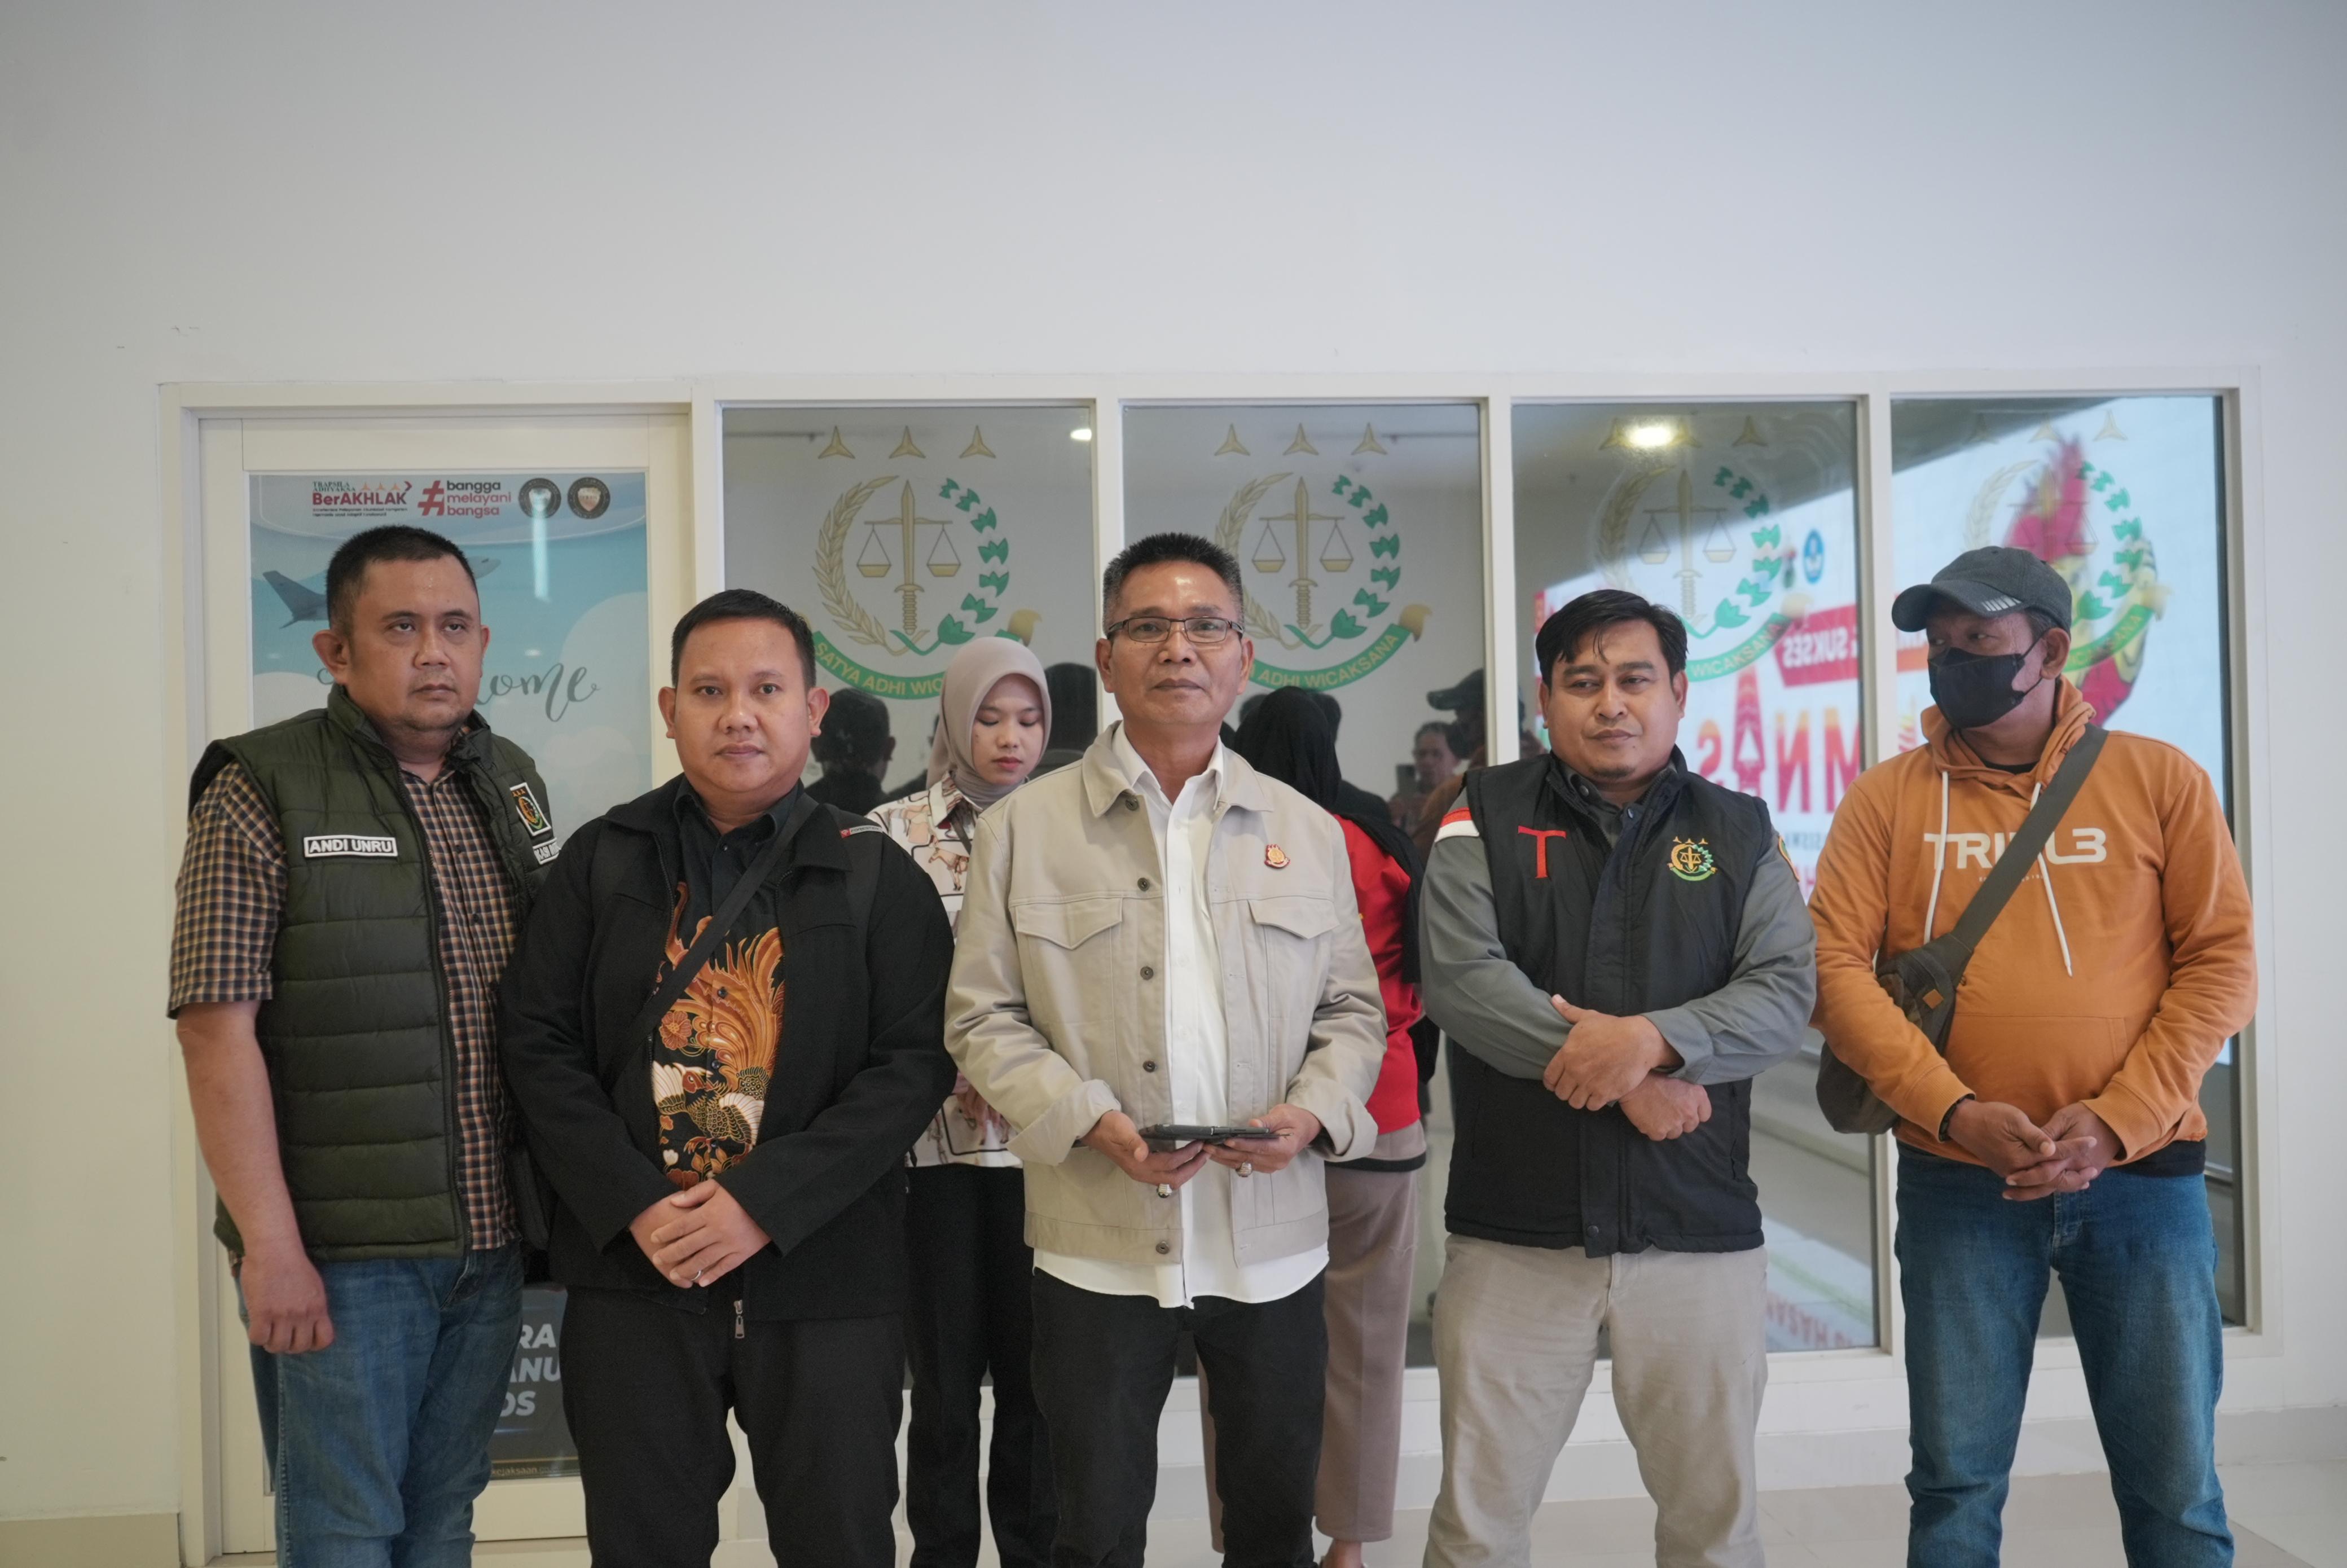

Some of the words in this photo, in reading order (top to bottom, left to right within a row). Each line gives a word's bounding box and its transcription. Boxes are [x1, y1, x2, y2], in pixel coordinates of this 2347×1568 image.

[447, 480, 501, 494] bangga
[313, 492, 407, 506] BerAKHLAK
[447, 491, 512, 506] melayani
[447, 505, 500, 519] bangsa
[1258, 669, 1300, 687] ADHI
[1305, 634, 1399, 688] WICAKSANA
[816, 642, 861, 684] SATYA
[862, 676, 906, 696] ADHI
[309, 838, 348, 853] ANDI
[351, 838, 393, 853] UNRU
[1923, 827, 2107, 869] TRIL3
